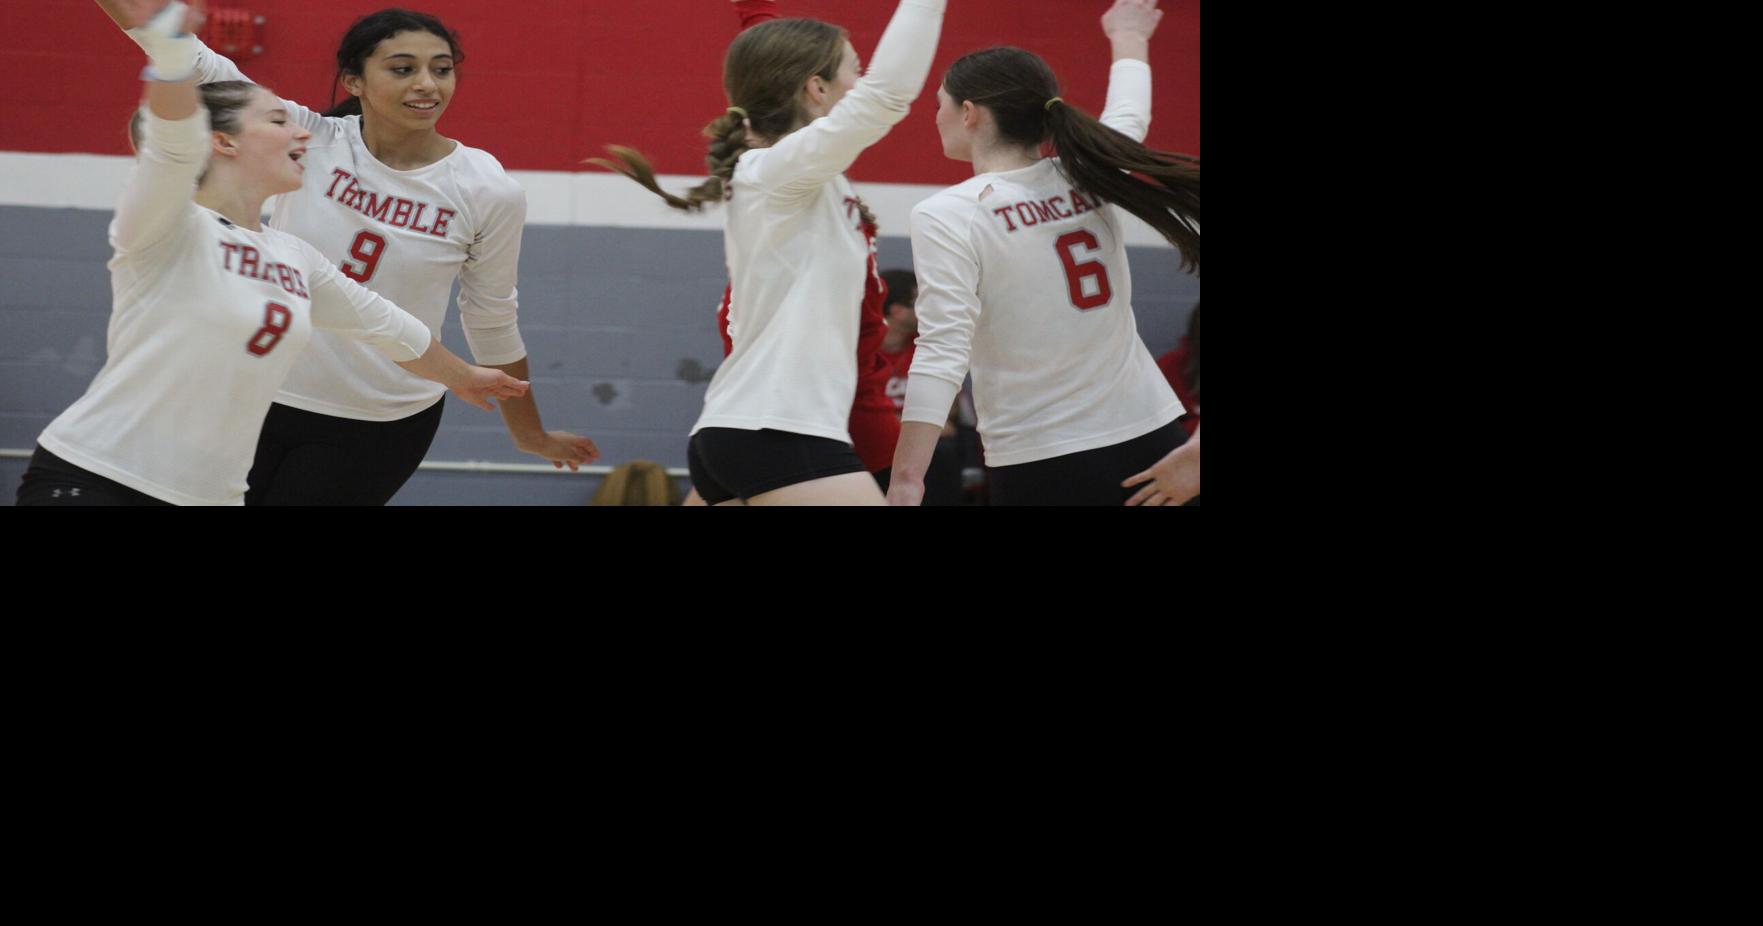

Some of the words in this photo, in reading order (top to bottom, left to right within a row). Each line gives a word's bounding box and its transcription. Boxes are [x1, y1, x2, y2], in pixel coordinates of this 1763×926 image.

[340, 229, 388, 284] 9
[1053, 228, 1113, 312] 6
[246, 302, 293, 357] 8
